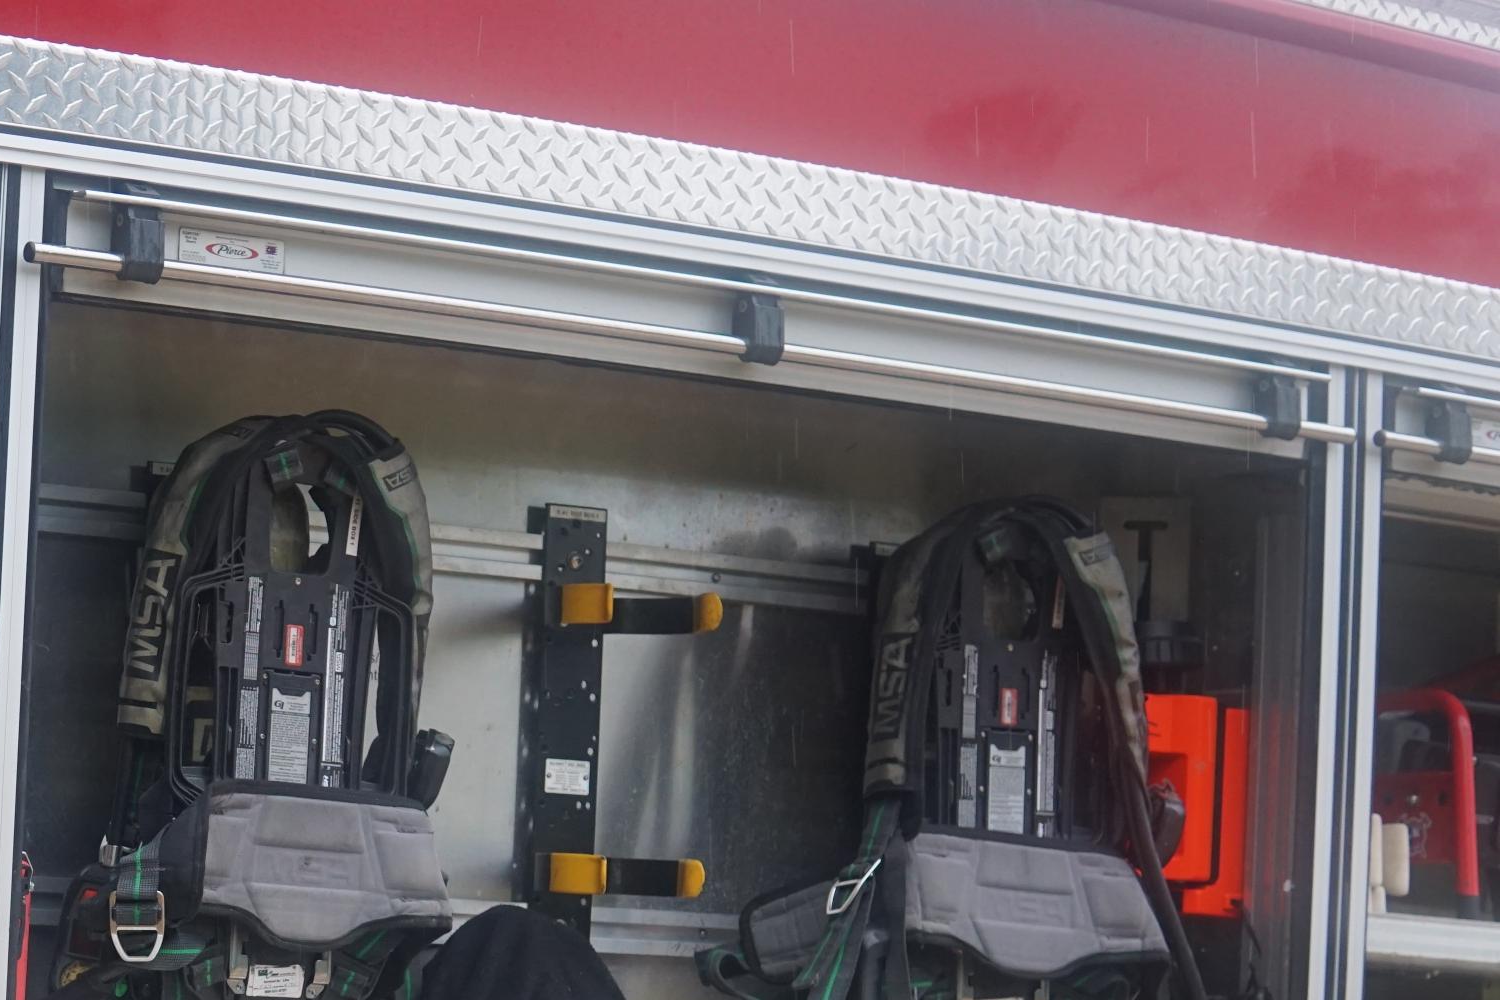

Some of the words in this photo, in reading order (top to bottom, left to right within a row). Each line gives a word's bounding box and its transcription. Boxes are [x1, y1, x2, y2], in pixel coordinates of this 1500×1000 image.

[217, 244, 247, 257] Pierce
[130, 558, 177, 674] MSA
[872, 638, 913, 736] MSA
